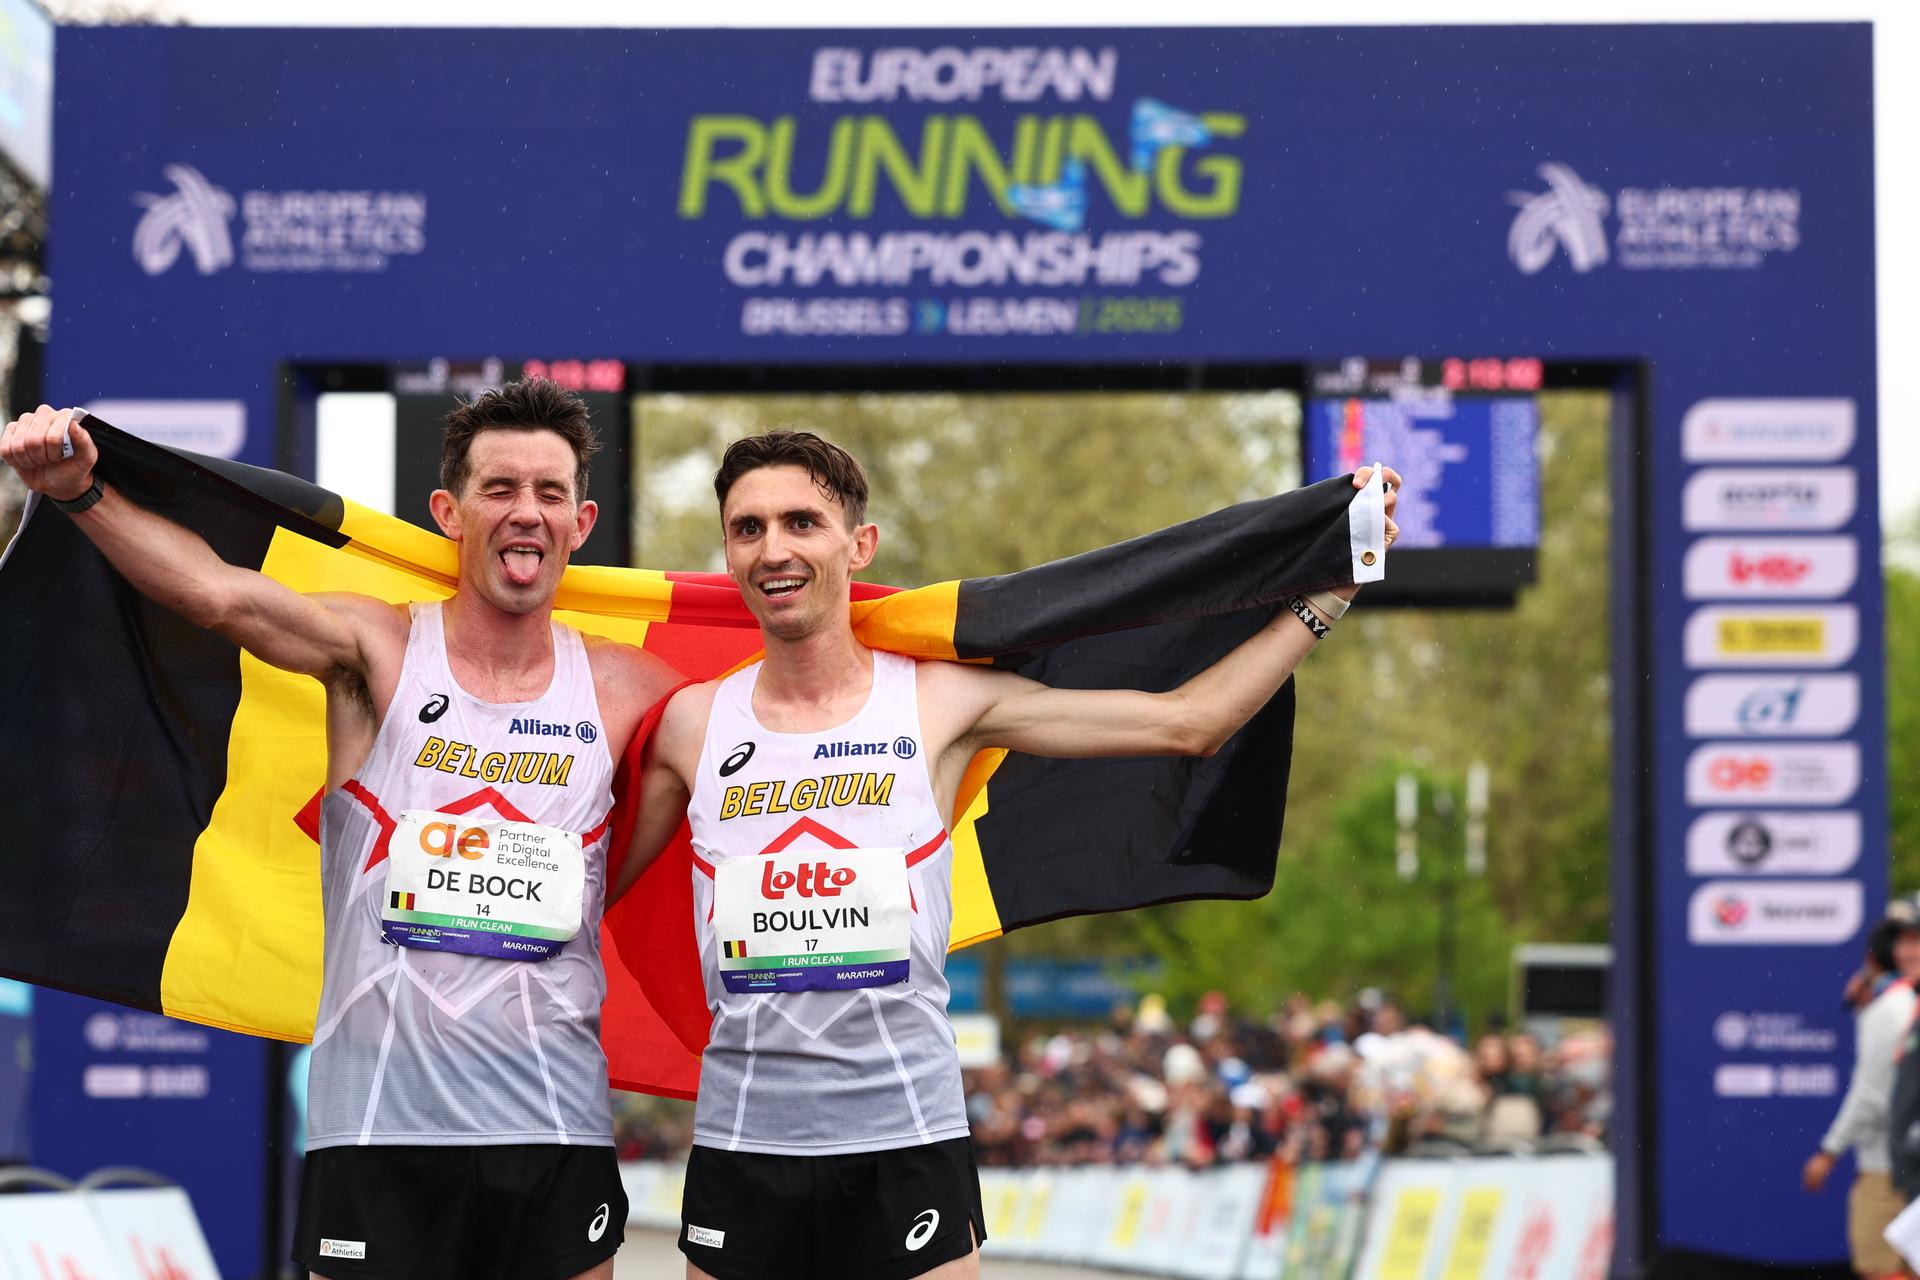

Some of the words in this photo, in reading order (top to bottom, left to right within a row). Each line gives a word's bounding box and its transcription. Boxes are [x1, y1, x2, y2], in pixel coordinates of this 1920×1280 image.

[811, 48, 1116, 100] EUROPEAN
[678, 114, 1246, 219] RUNNING
[724, 231, 1199, 285] CHAMPIONSHIPS
[742, 299, 908, 334] BRUSSELS
[948, 299, 1076, 334] LEUVEN
[508, 719, 572, 737] Allianz
[813, 741, 888, 759] Allianz
[414, 736, 574, 787] BELGIUM
[720, 773, 895, 821] BELGIUM
[500, 829, 546, 845] Partner
[498, 843, 509, 852] in
[512, 844, 551, 858] Digital
[497, 854, 559, 872] Excellence
[427, 869, 462, 892] DE
[469, 874, 543, 902] BOCK
[761, 861, 856, 899] lotto
[476, 904, 490, 917] 14
[456, 918, 478, 928] RUN
[479, 921, 512, 932] CLEAN
[753, 907, 869, 932] BOULVIN
[408, 927, 441, 937] RUNNING
[502, 941, 549, 953] MARATHON
[804, 939, 818, 951] 17
[787, 957, 809, 966] RUN
[810, 955, 844, 965] CLEAN
[747, 972, 776, 981] RUNNING
[836, 969, 885, 980] MARATHON
[695, 1235, 721, 1246] Athletics
[331, 1248, 363, 1257] Athletics
